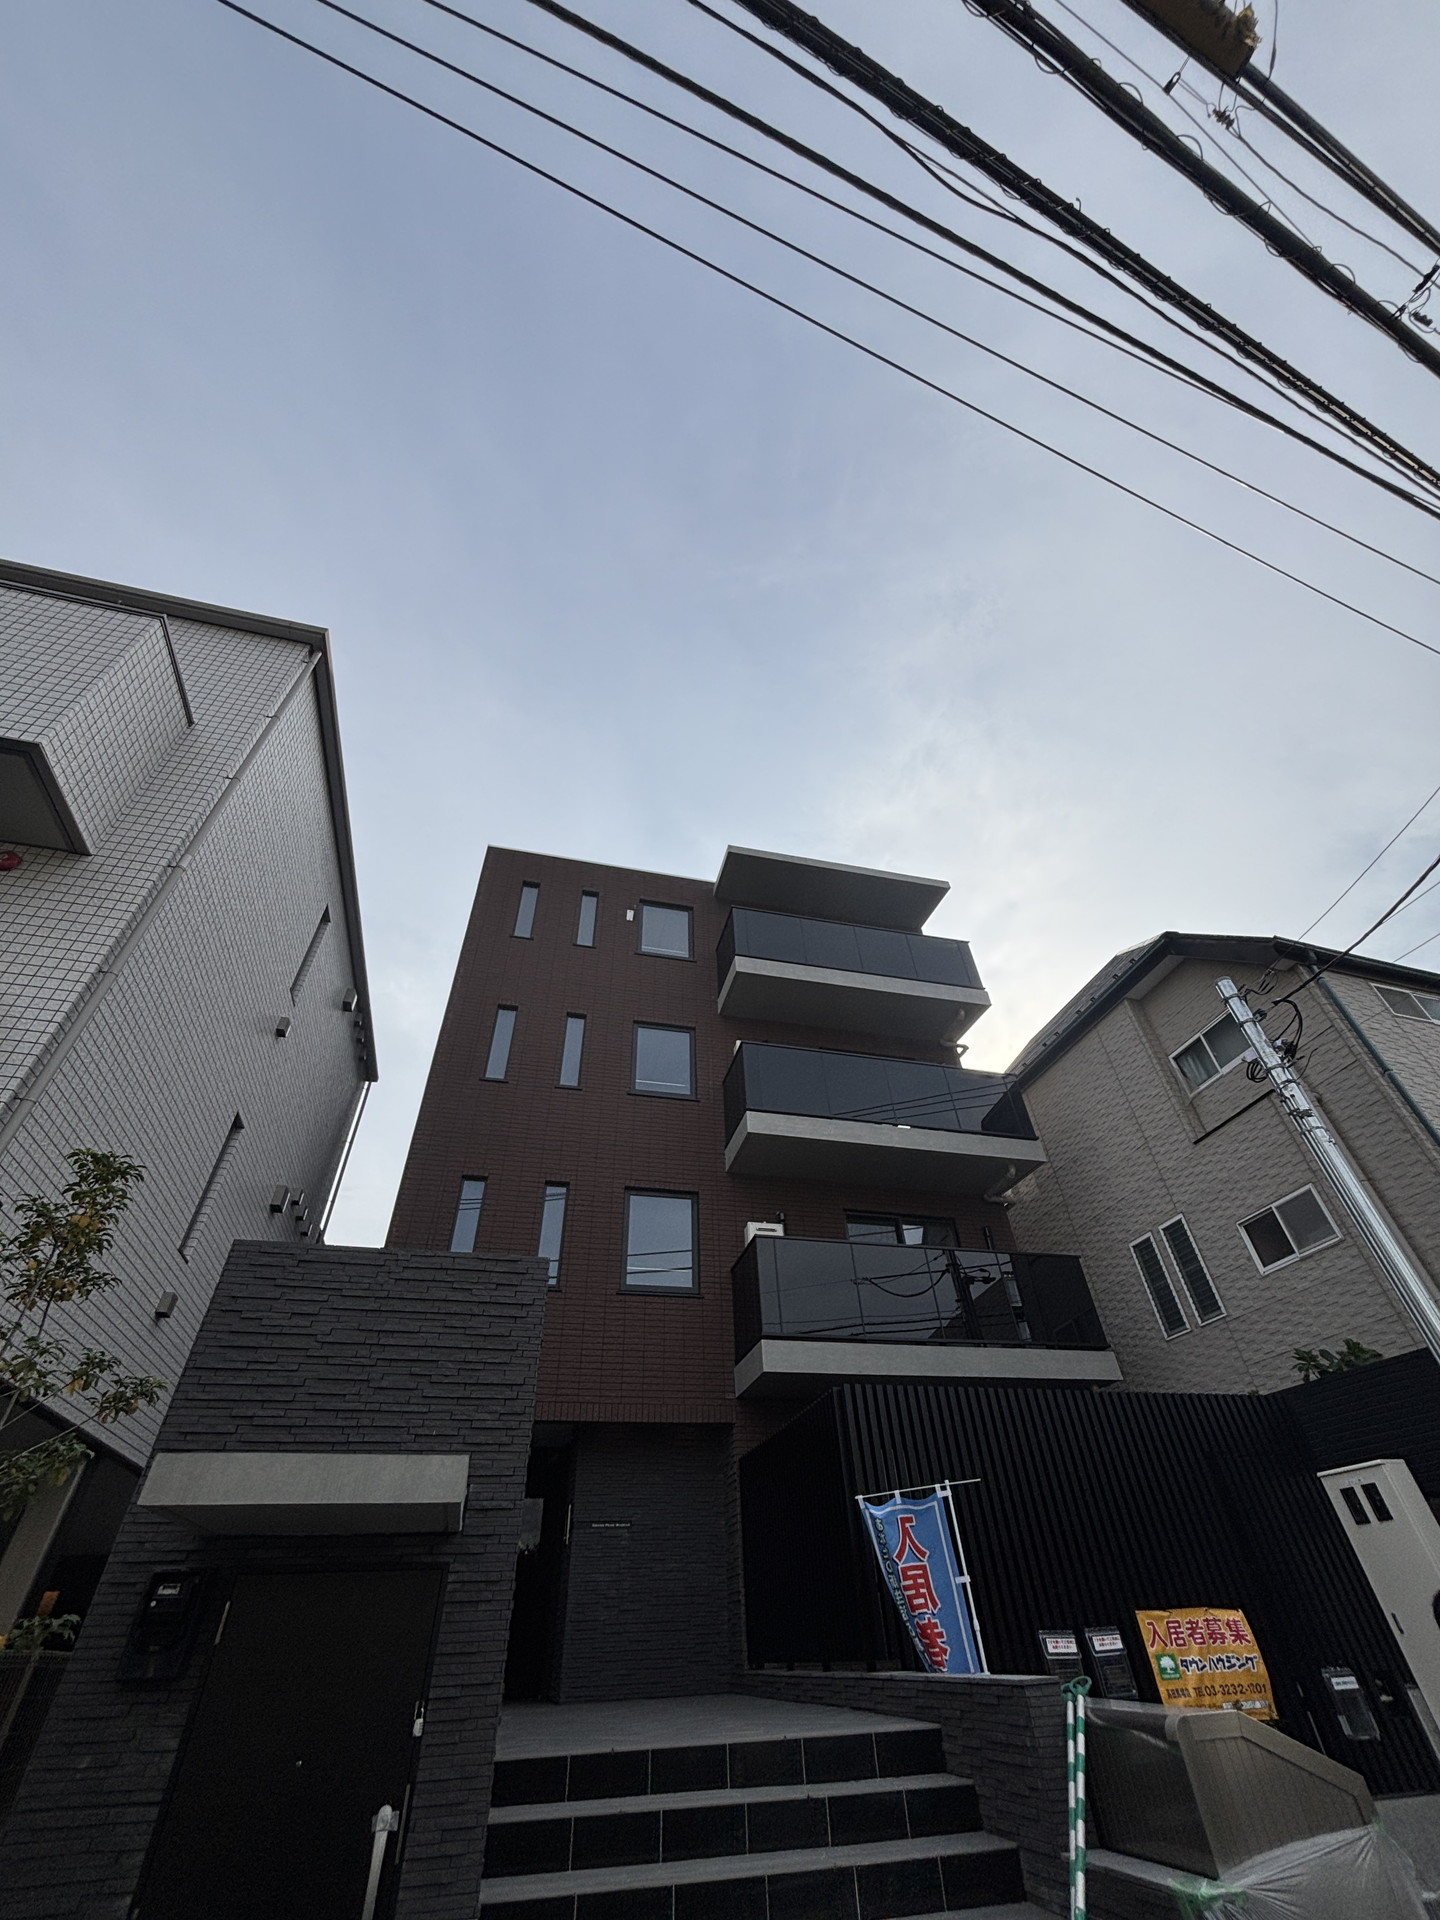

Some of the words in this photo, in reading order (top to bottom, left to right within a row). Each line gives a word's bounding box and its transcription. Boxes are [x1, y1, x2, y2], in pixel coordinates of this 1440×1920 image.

[1146, 1617, 1252, 1649] 入居者募集
[1180, 1654, 1258, 1674] タウンハウジング
[1194, 1686, 1205, 1698] TEL
